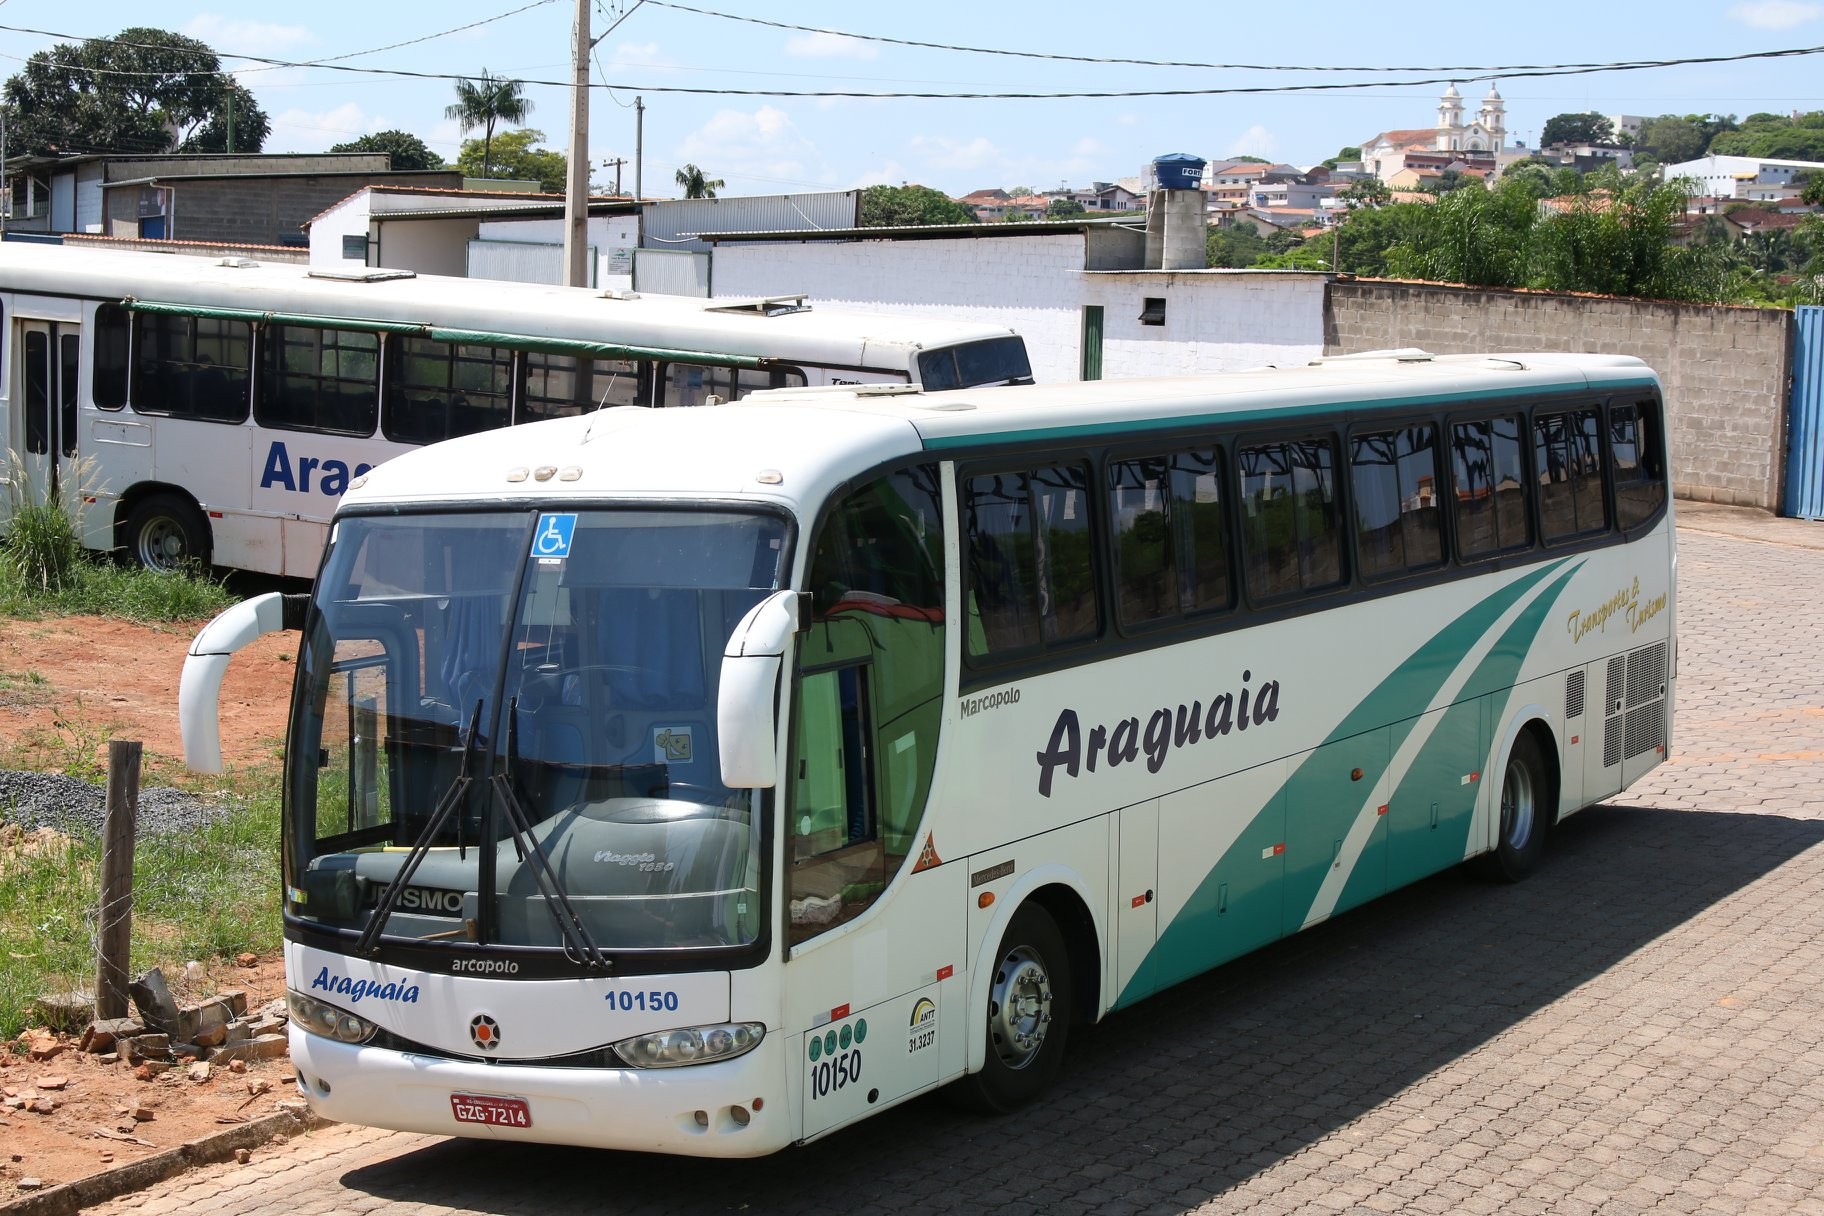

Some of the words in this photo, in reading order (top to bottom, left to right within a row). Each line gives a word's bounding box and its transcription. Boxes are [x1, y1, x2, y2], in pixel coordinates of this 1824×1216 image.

[1567, 587, 1630, 645] Transportes
[1632, 575, 1640, 599] &
[1626, 592, 1667, 634] Turismo
[960, 687, 1021, 720] Marcopolo
[1036, 669, 1280, 799] Araguaia
[593, 850, 656, 866] Viaggio
[452, 959, 519, 974] arcopolo
[311, 966, 420, 1003] Araguaia
[605, 990, 679, 1011] 10150
[920, 1009, 936, 1022] ANTT
[908, 1030, 935, 1053] 31.3237
[811, 1049, 862, 1101] 10150
